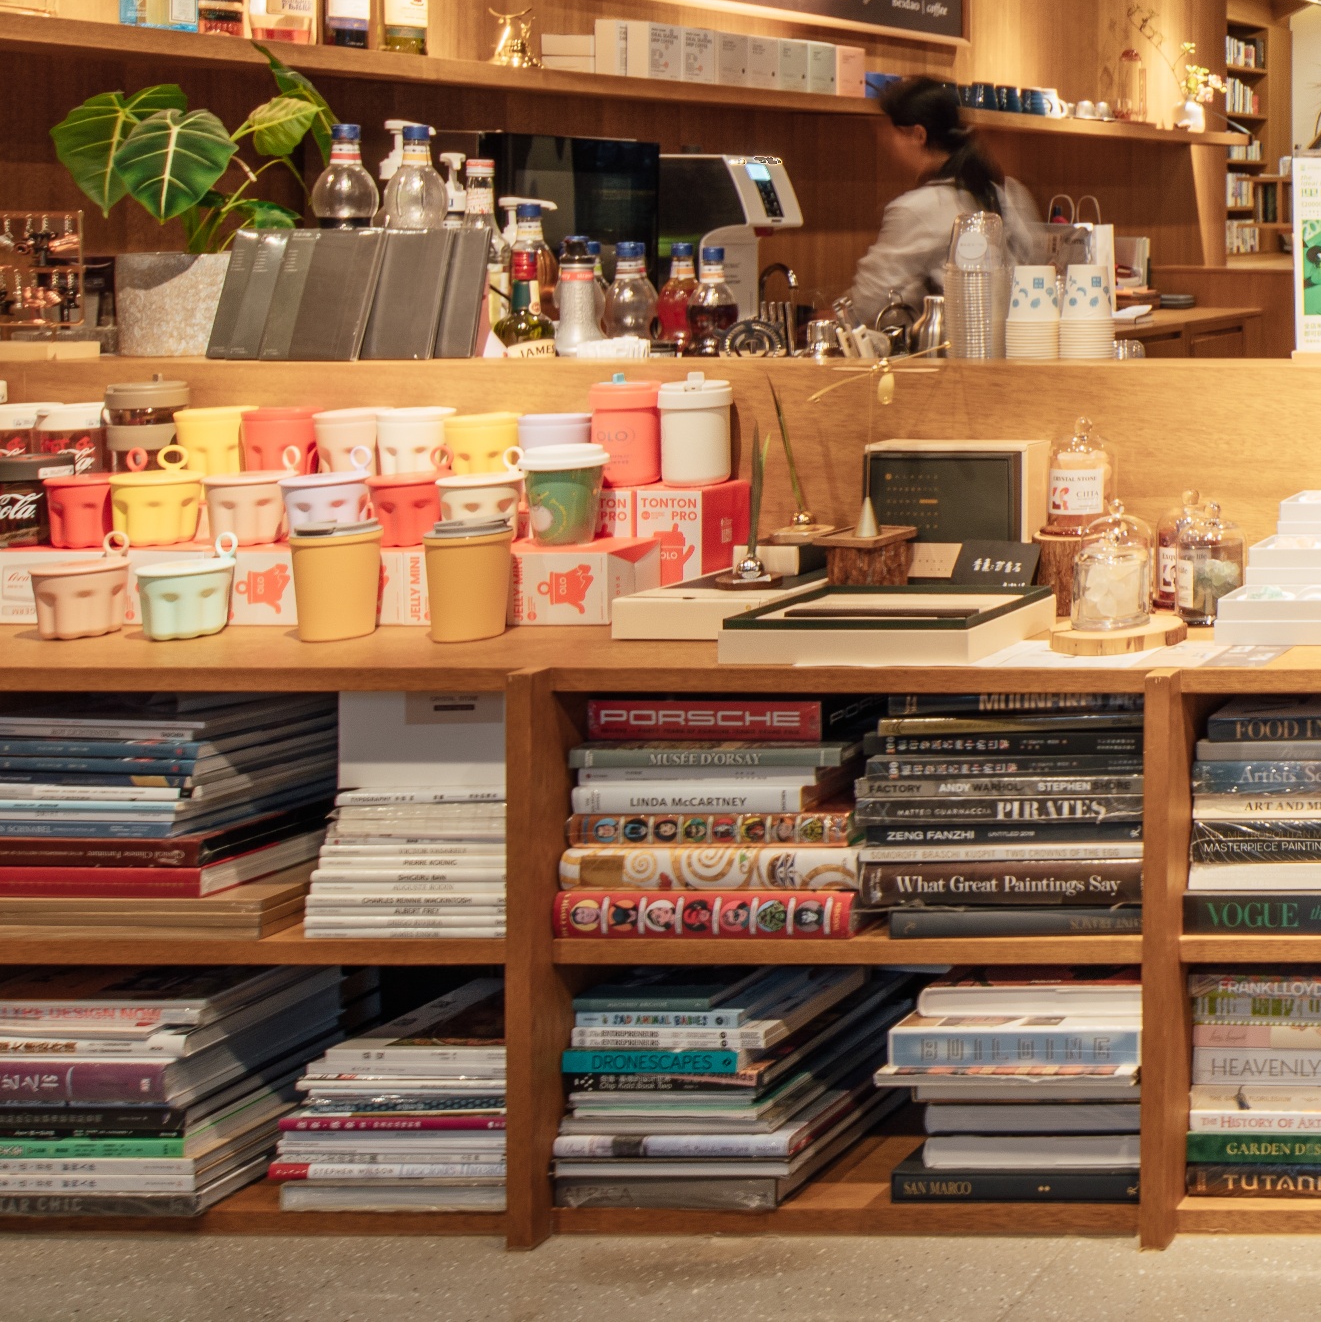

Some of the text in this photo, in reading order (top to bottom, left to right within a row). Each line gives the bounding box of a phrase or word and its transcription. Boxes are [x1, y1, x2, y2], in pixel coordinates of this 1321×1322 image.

[641, 498, 697, 508] TONTON
[671, 511, 698, 521] PRO
[410, 556, 421, 621] JELLY MINI
[514, 557, 524, 621] JELLY MINI
[600, 709, 801, 727] PORSCHE
[1234, 719, 1299, 740] FOOD
[649, 751, 762, 766] MUSÉE D'ORSAY
[869, 780, 1132, 794] FACTORY ANDY WARHOL STEPHEN SHORE
[630, 797, 748, 808] LINDA McCARTNEY
[1244, 800, 1273, 812] ART
[1275, 800, 1304, 811] AND
[897, 799, 1108, 821] MATTEO PIRATES
[887, 830, 975, 841] ZENG FANZHI
[1230, 829, 1311, 840] METROPOLITAN
[921, 850, 961, 860] BRASCHI
[1005, 848, 1026, 858] TWO
[1028, 848, 1067, 858] CROWNS
[1069, 848, 1084, 858] OF
[1085, 848, 1101, 857] THE
[1102, 847, 1120, 857] EGG
[1203, 840, 1279, 853] MASTERPIECE
[896, 875, 1122, 896] What Great Paintings Say
[1204, 901, 1300, 928] VOGUE
[1218, 981, 1272, 995] FRANK
[612, 1014, 633, 1025] SAD
[635, 1014, 672, 1025] ANIMAL
[591, 1054, 713, 1071] DRONESCAPES
[1220, 1114, 1275, 1128] HISTORY
[1277, 1116, 1295, 1128] OF
[1296, 1116, 1321, 1129] ART
[1226, 1142, 1292, 1156] GARDEN
[903, 1181, 973, 1196] SAN MARCO
